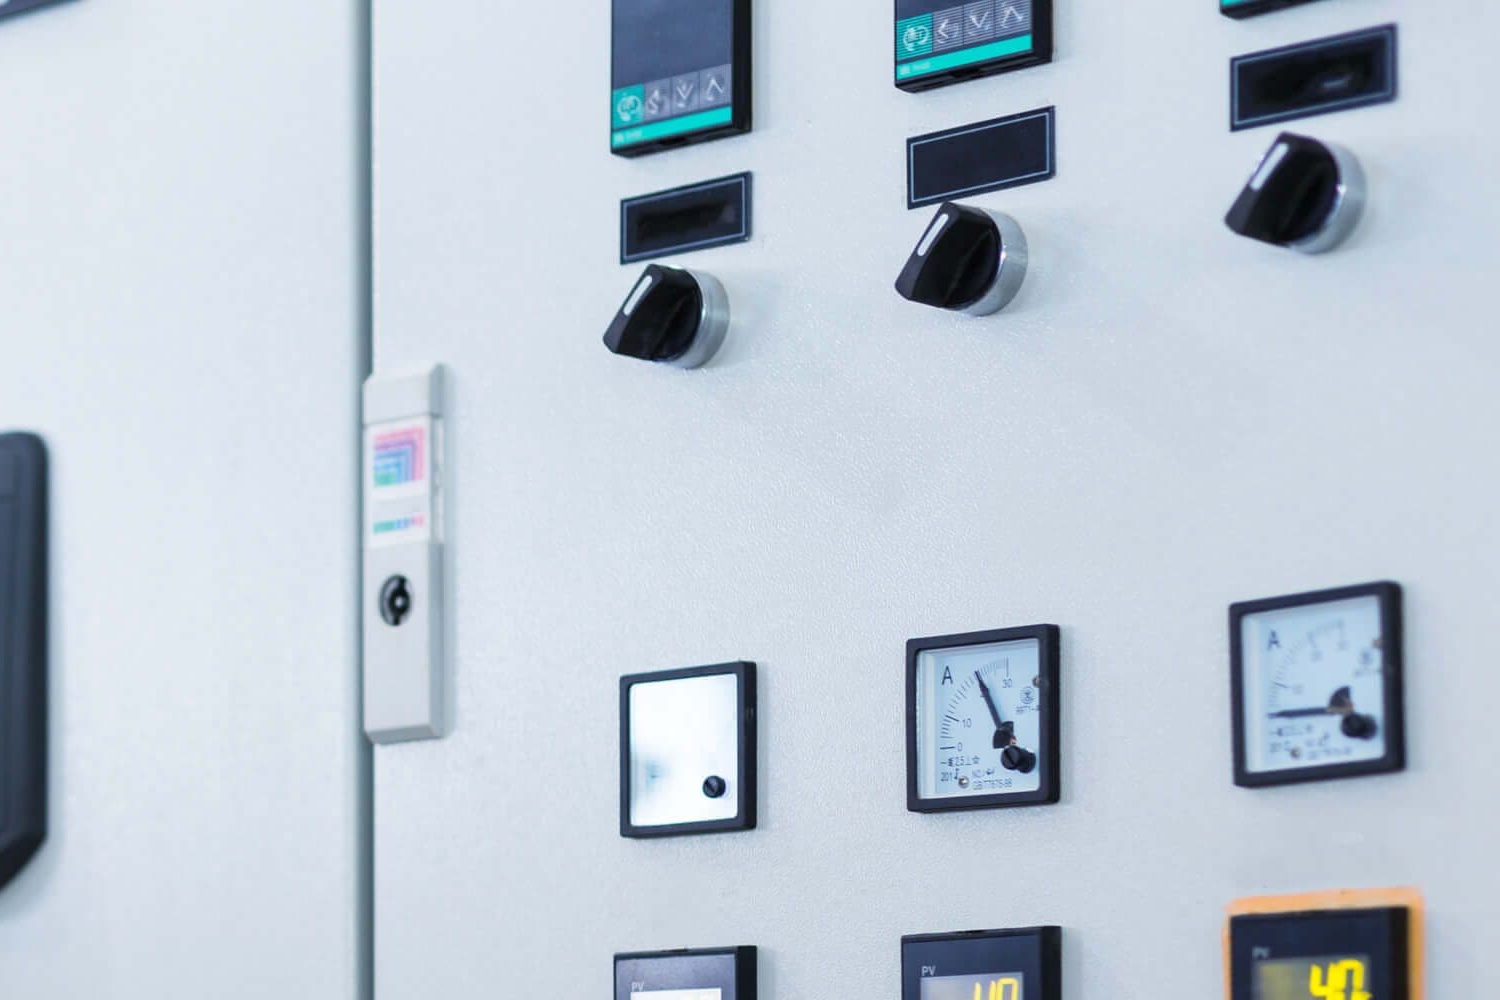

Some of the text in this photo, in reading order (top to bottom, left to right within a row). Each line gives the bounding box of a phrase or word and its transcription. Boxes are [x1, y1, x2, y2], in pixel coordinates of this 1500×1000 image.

[1268, 629, 1281, 649] A
[941, 666, 953, 686] A
[1002, 679, 1013, 689] 30
[962, 717, 973, 728] 10
[921, 966, 936, 976] PV
[631, 982, 644, 991] PV
